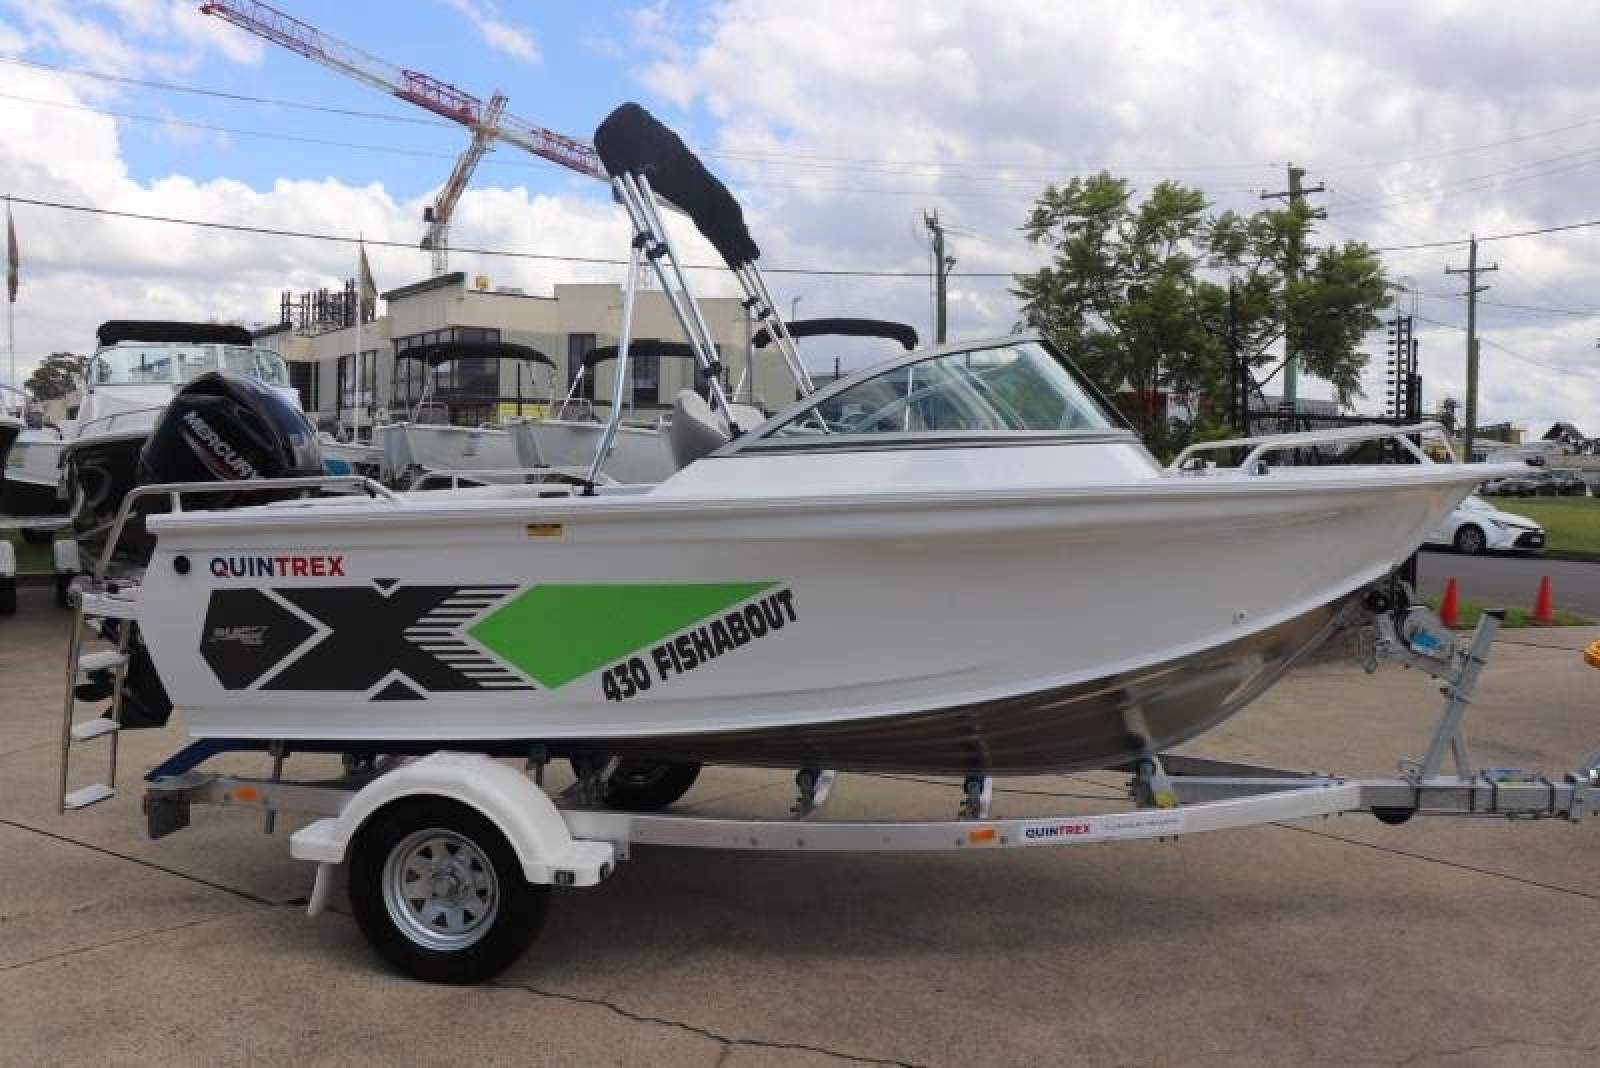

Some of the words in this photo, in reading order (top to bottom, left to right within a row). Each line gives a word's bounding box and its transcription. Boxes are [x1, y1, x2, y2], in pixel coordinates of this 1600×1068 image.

[209, 556, 345, 578] QUINTREX
[601, 657, 652, 702] 430
[652, 588, 797, 680] FISHABOUT
[1025, 822, 1090, 839] QUINTREX
